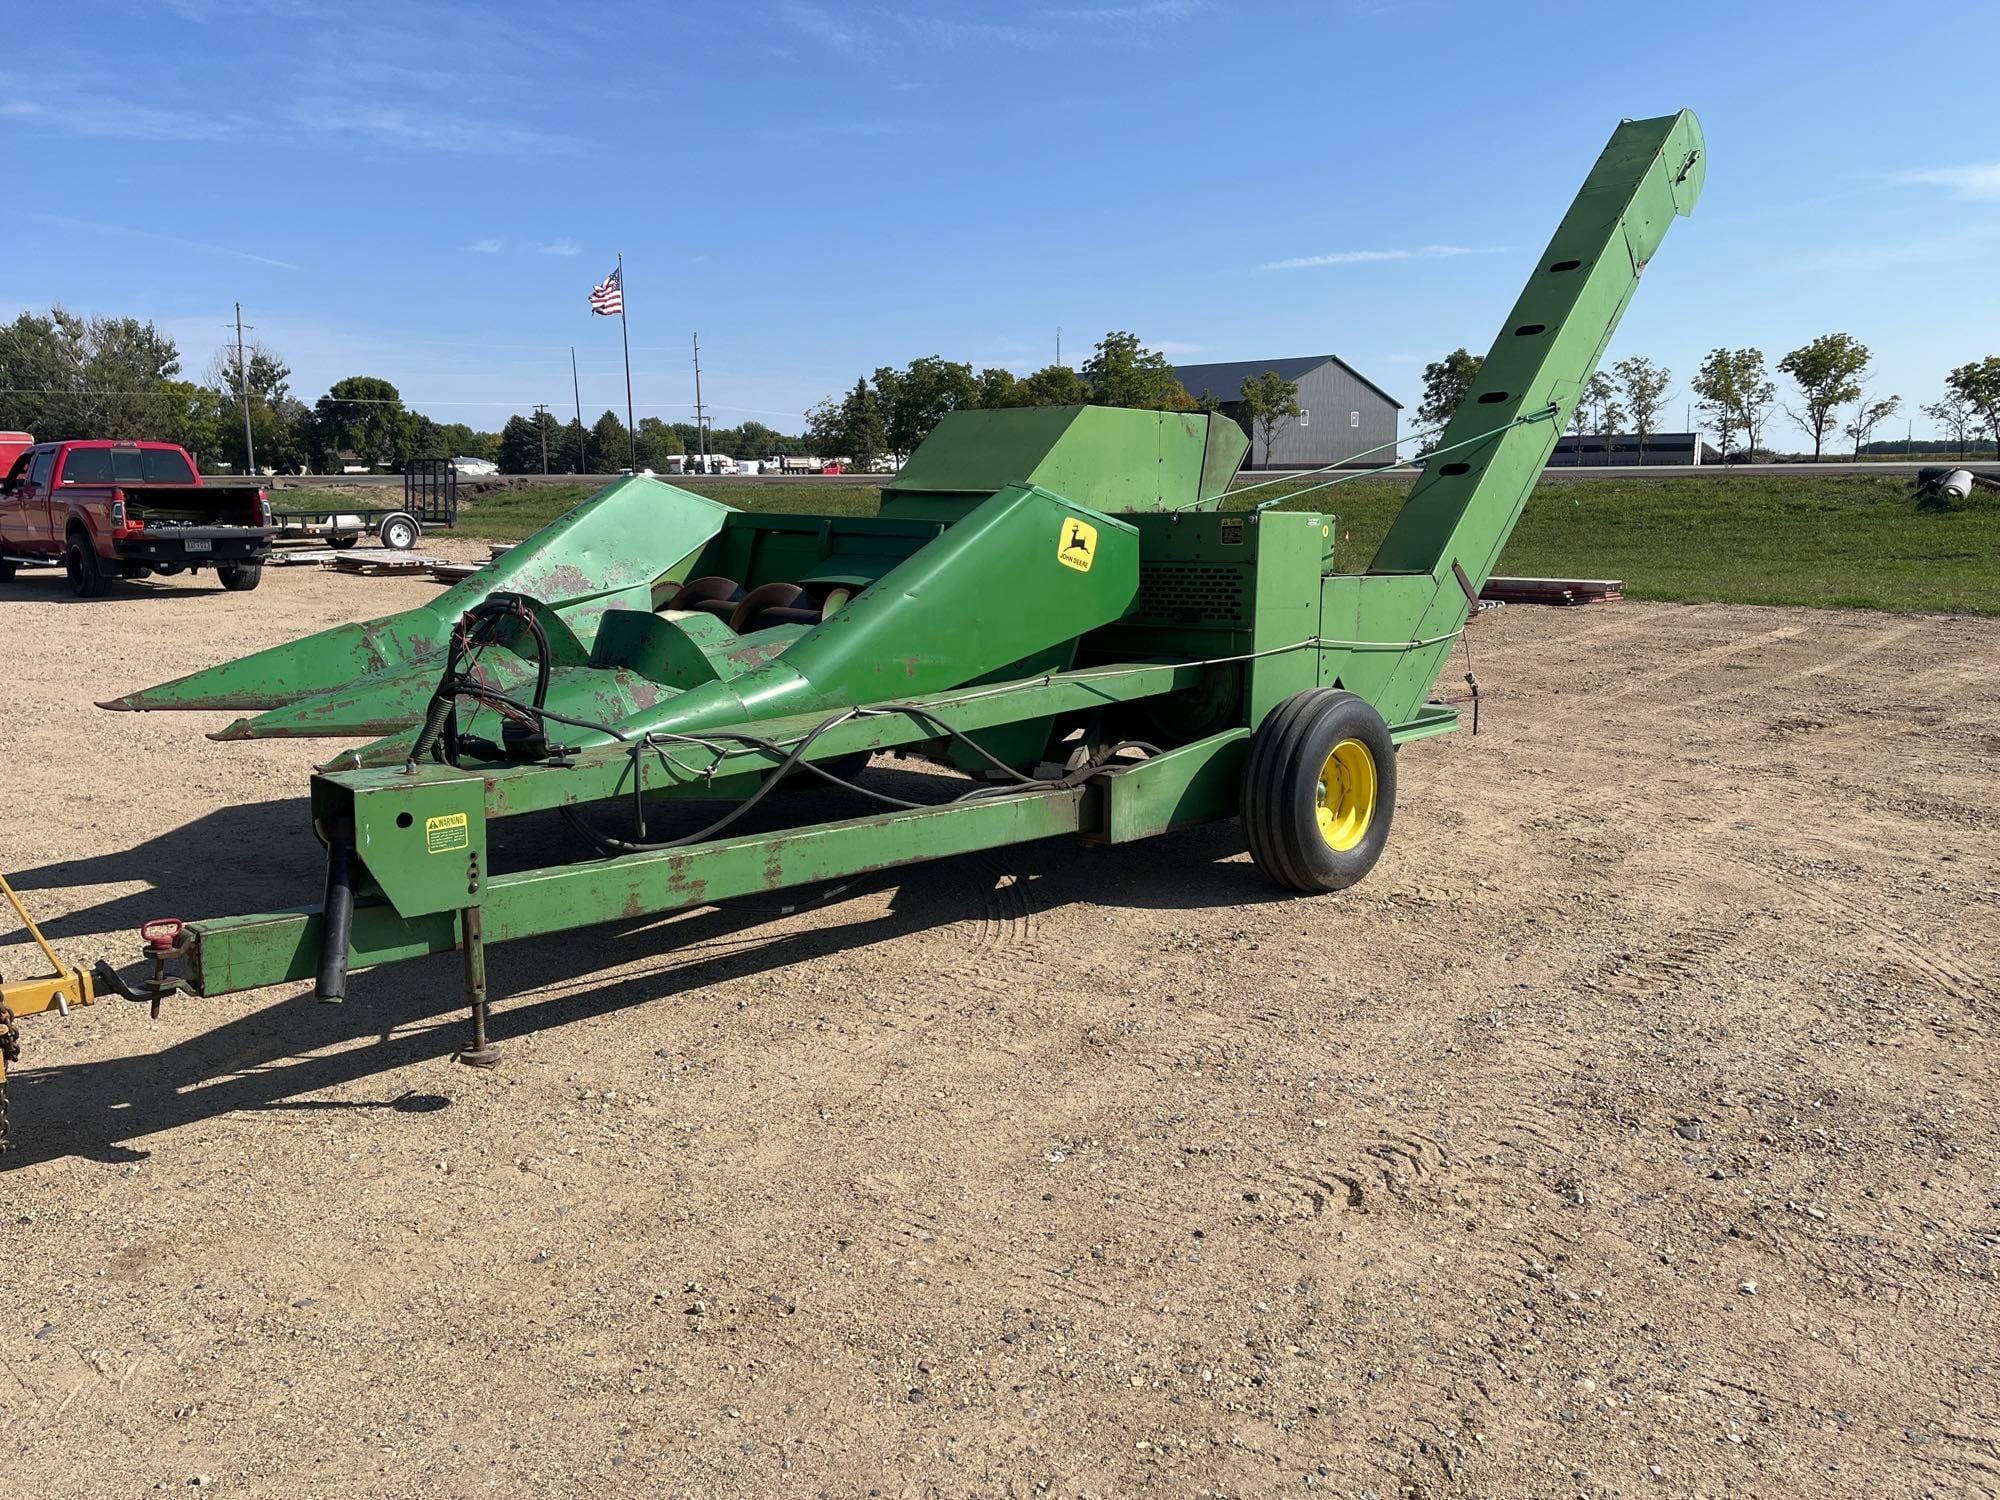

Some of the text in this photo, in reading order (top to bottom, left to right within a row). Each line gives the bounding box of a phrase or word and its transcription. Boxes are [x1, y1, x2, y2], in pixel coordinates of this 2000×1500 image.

[1060, 553, 1088, 568] JOHN DEERE
[438, 815, 464, 827] WARNING
